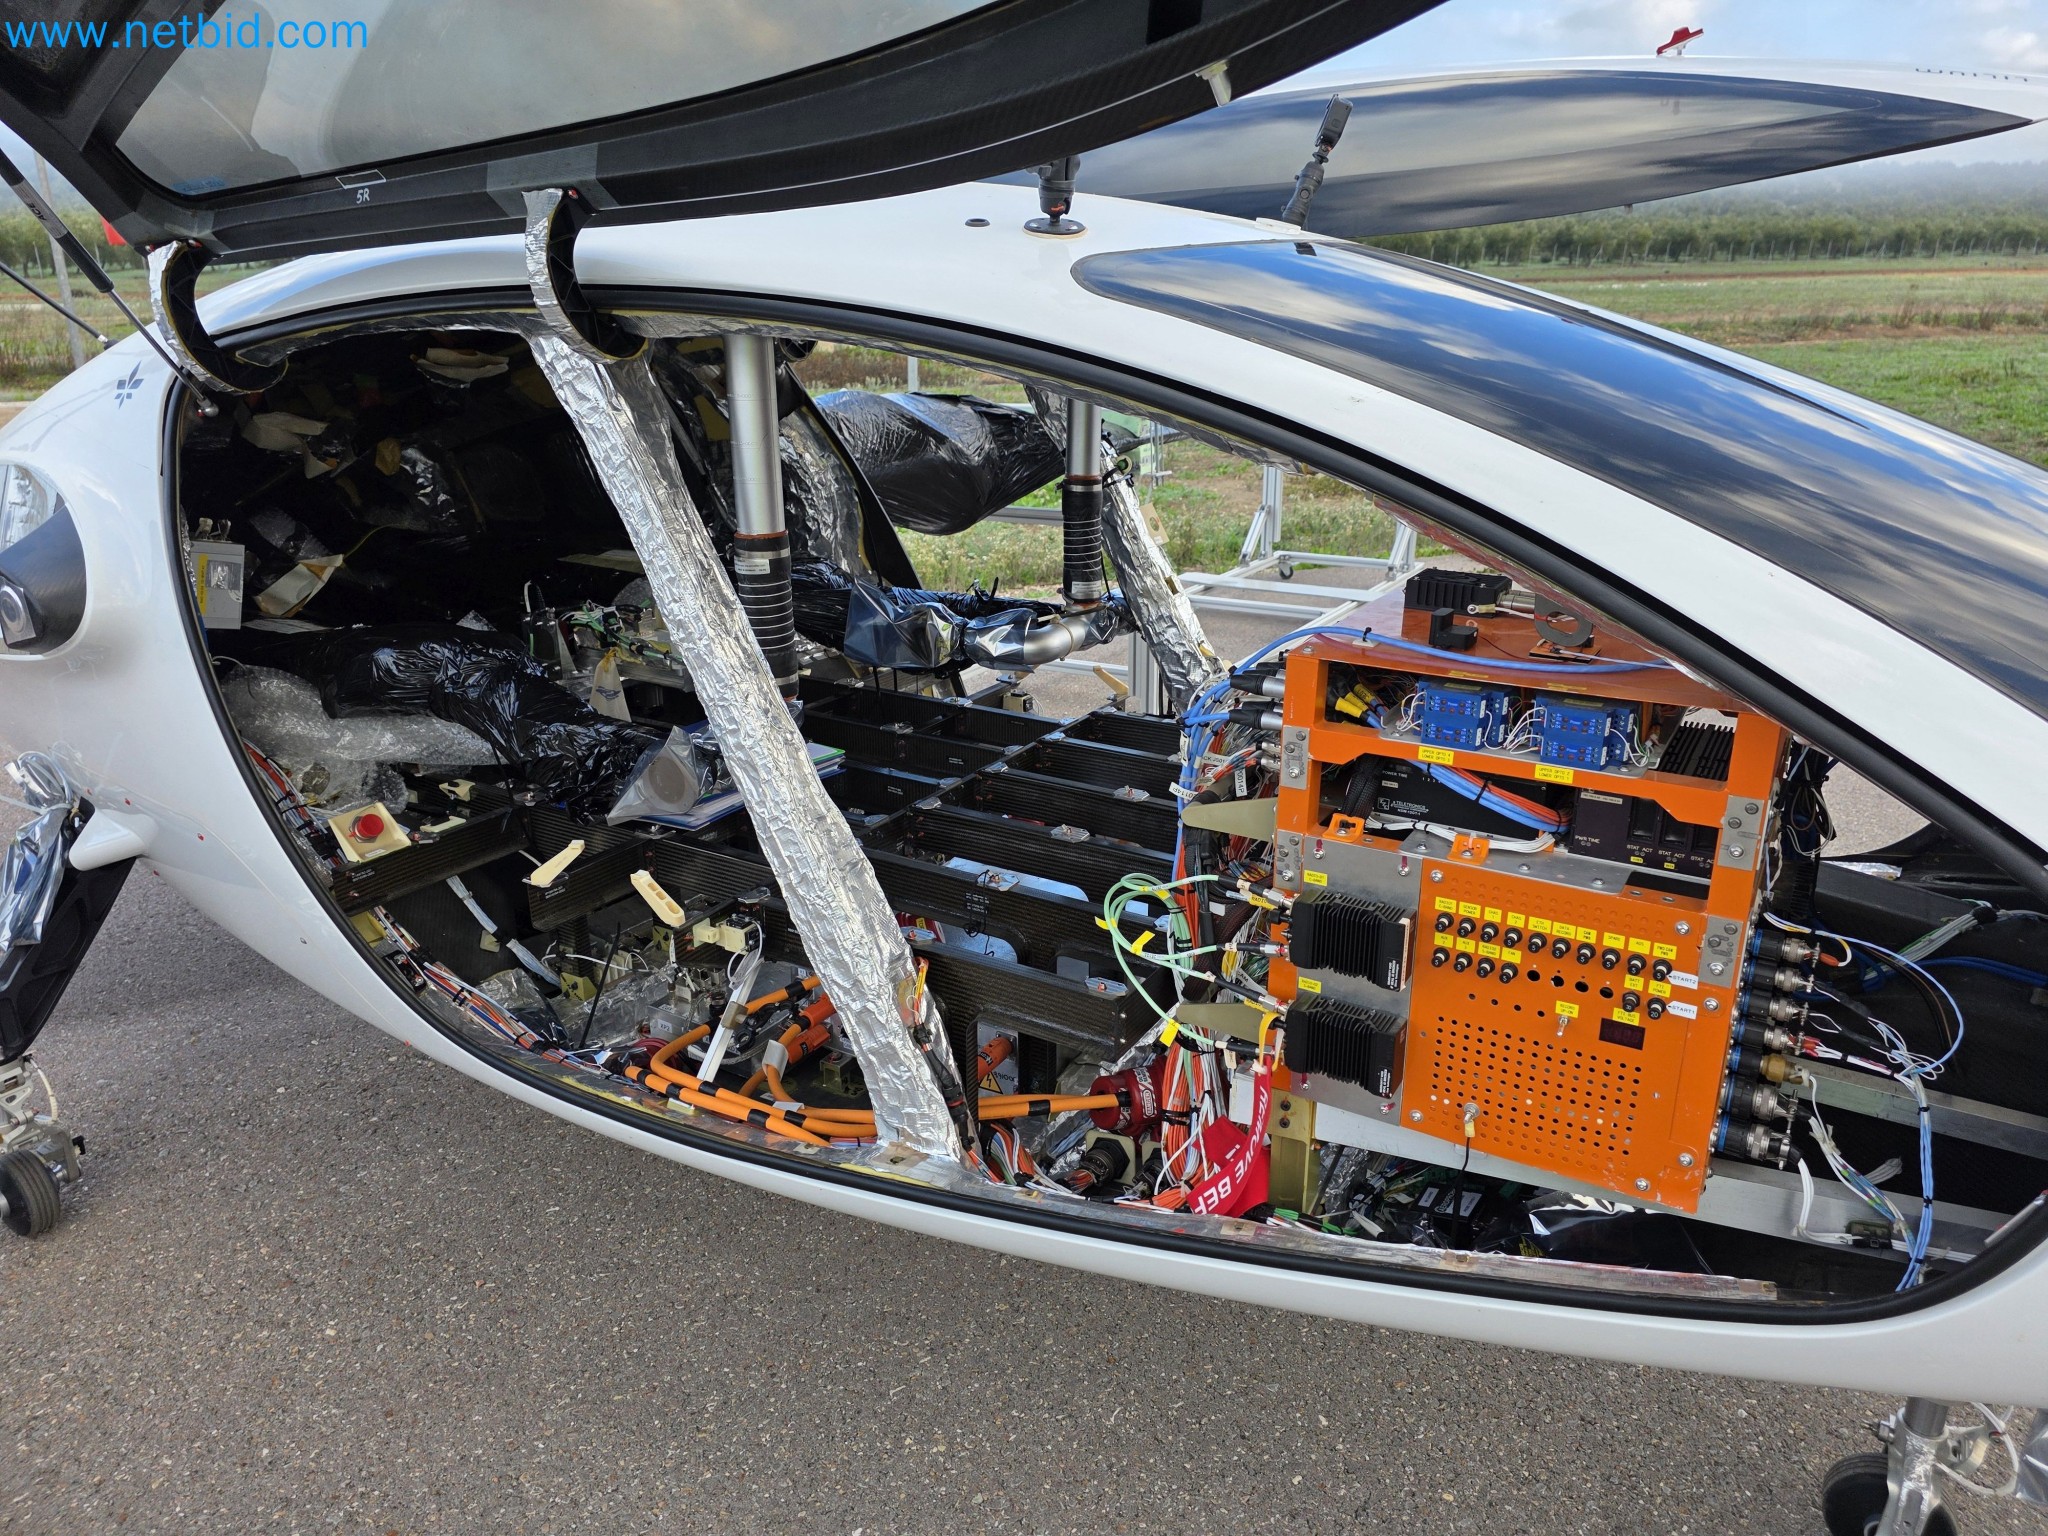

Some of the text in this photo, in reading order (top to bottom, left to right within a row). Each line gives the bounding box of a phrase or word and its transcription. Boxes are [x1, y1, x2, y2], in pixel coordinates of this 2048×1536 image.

[356, 188, 370, 204] 5R
[27, 203, 47, 220] ACE
[1672, 975, 1696, 984] START2
[1672, 1006, 1695, 1014] START1
[1235, 1086, 1269, 1185] REMOVE
